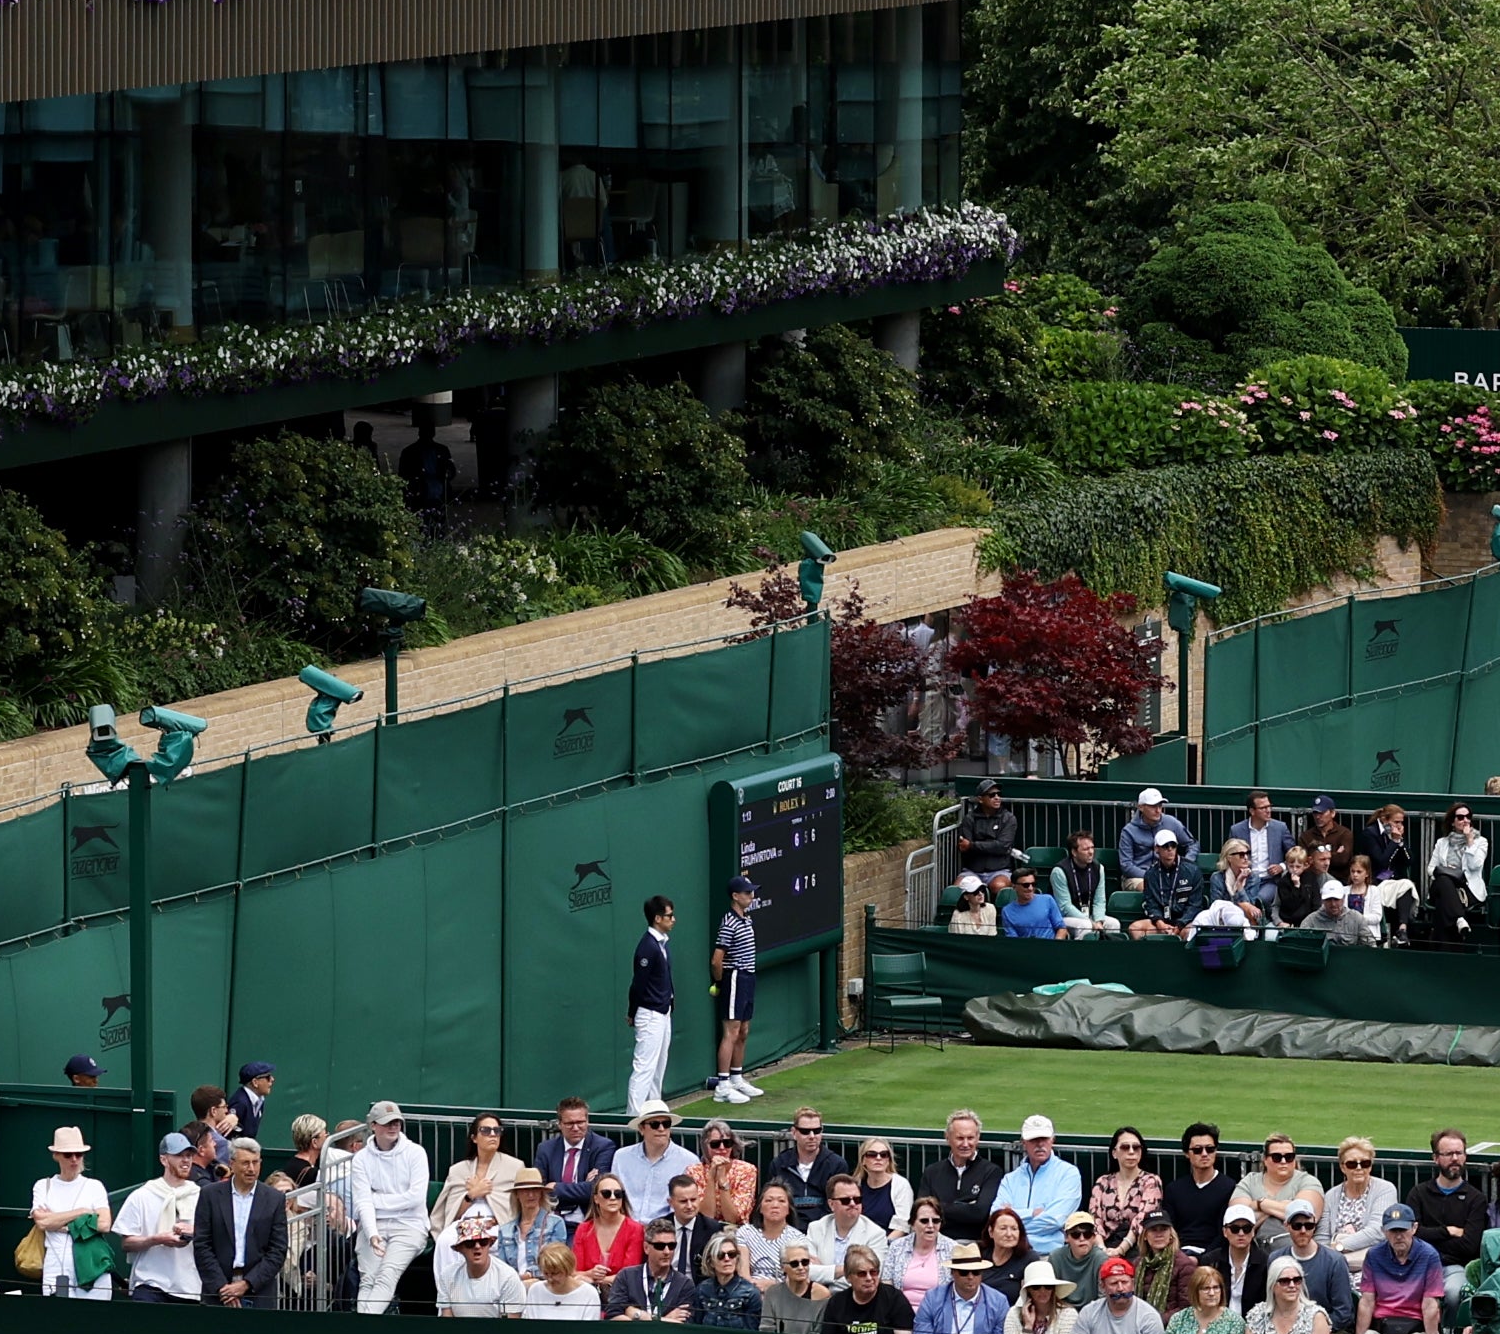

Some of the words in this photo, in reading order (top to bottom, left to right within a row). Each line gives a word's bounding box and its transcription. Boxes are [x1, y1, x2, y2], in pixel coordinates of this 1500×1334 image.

[778, 779, 794, 793] COURT
[779, 797, 799, 812] ROLEX
[740, 841, 755, 855] Linda
[568, 886, 612, 908] Slazenger
